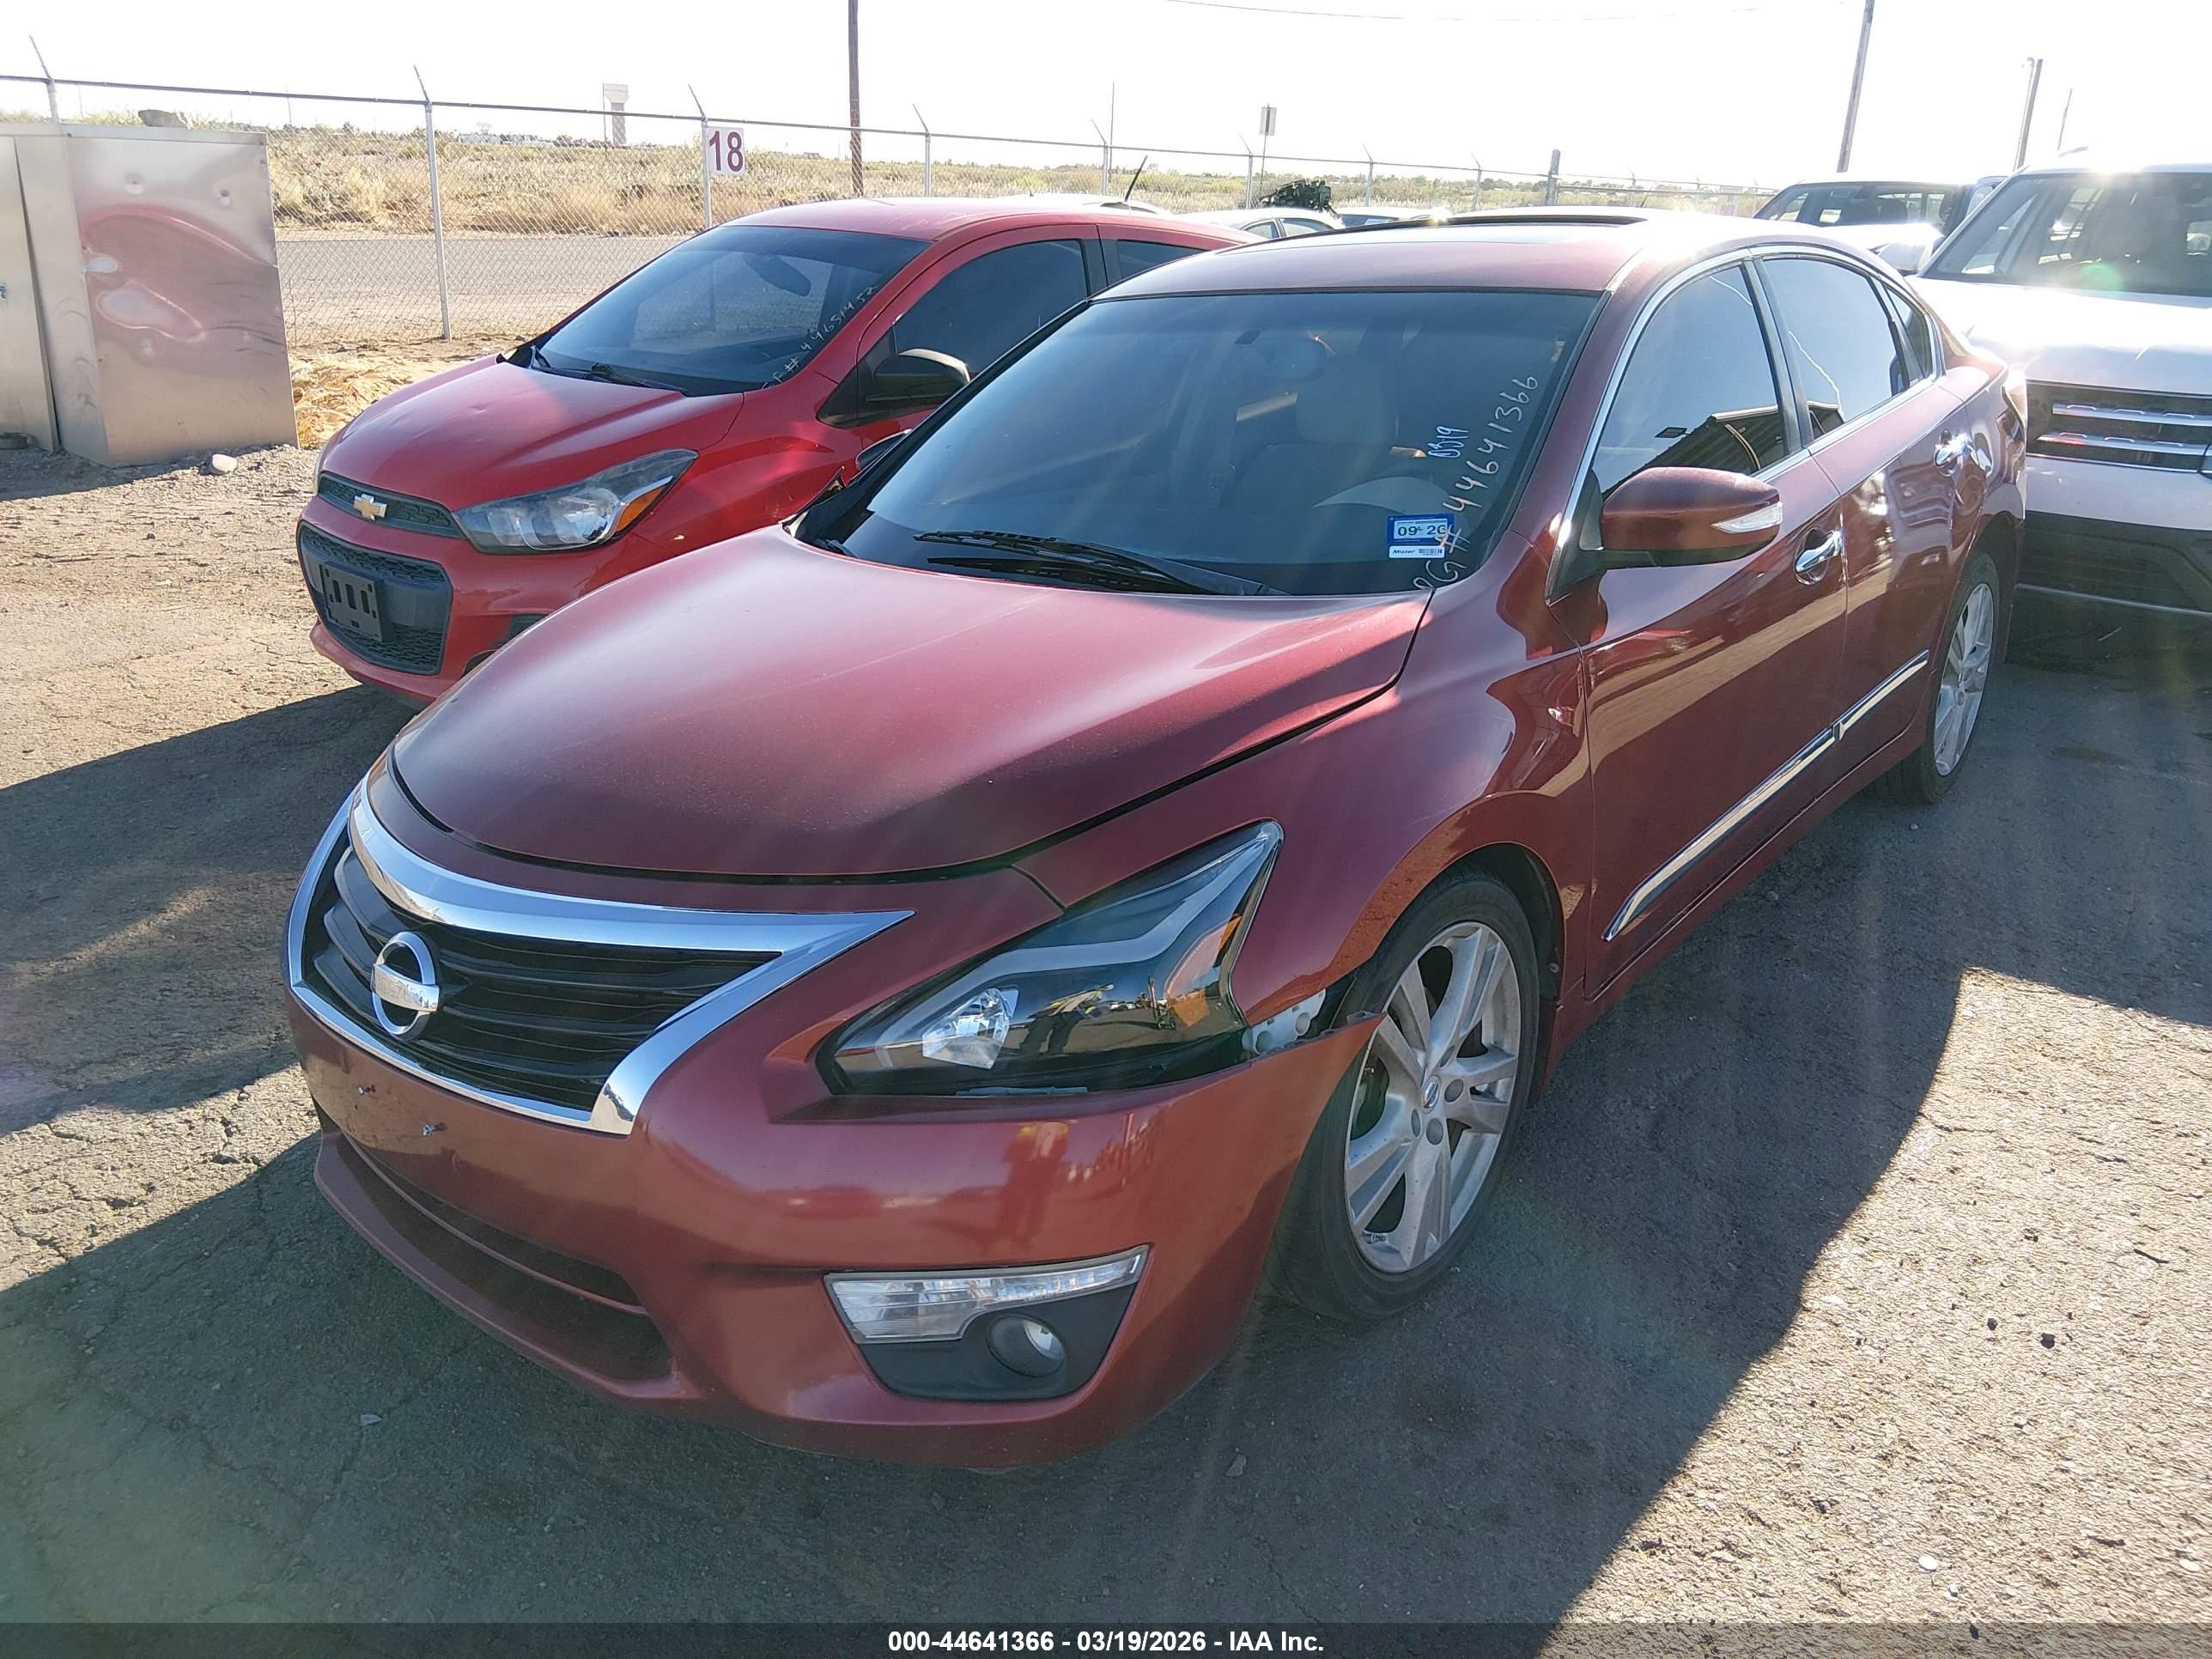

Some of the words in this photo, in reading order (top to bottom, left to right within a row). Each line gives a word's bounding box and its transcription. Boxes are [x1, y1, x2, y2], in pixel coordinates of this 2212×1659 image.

[708, 131, 744, 173] 18
[1442, 376, 1539, 512] 44641366
[1398, 526, 1418, 537] 09
